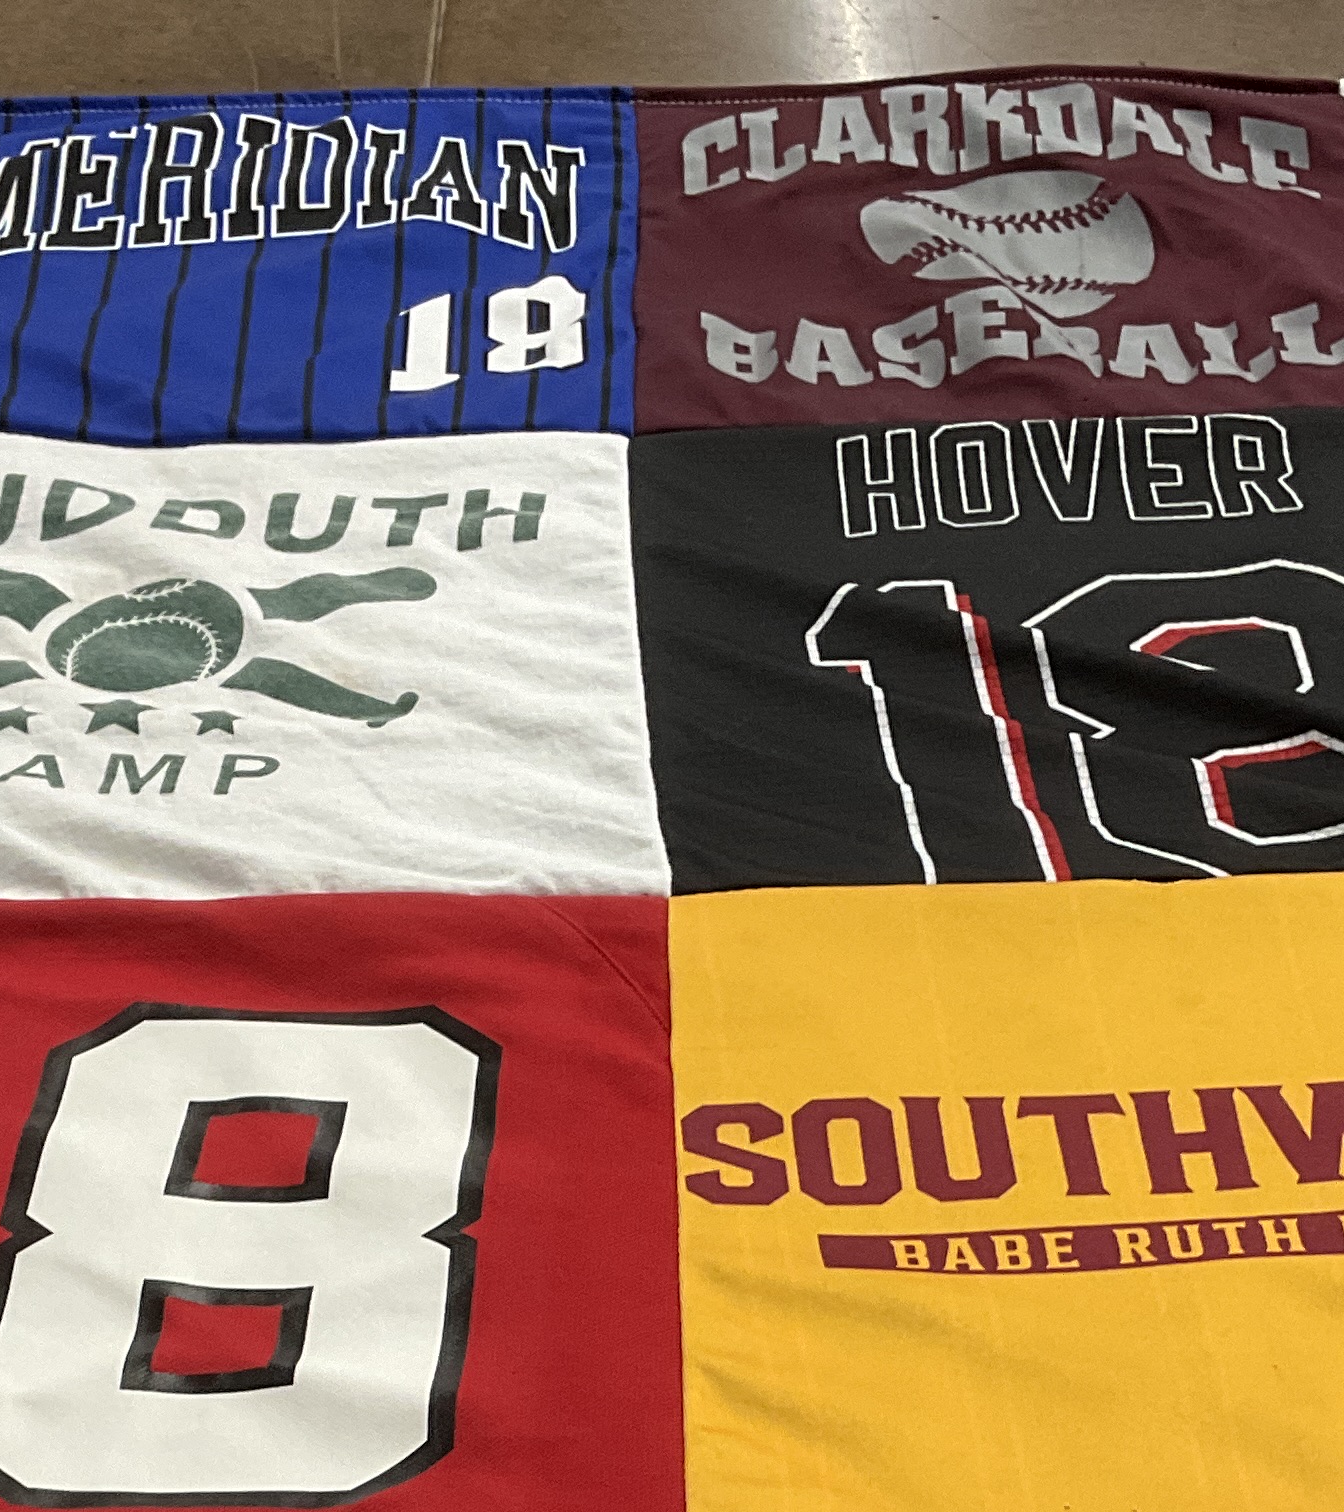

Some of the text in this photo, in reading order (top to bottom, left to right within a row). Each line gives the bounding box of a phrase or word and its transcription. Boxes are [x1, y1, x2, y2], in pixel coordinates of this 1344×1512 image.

[681, 82, 1322, 198] CLARKDALE
[390, 275, 587, 392] 18
[836, 414, 1304, 539] HOVER
[890, 1235, 1080, 1272] BABE
[1113, 1214, 1308, 1264] RUTH
